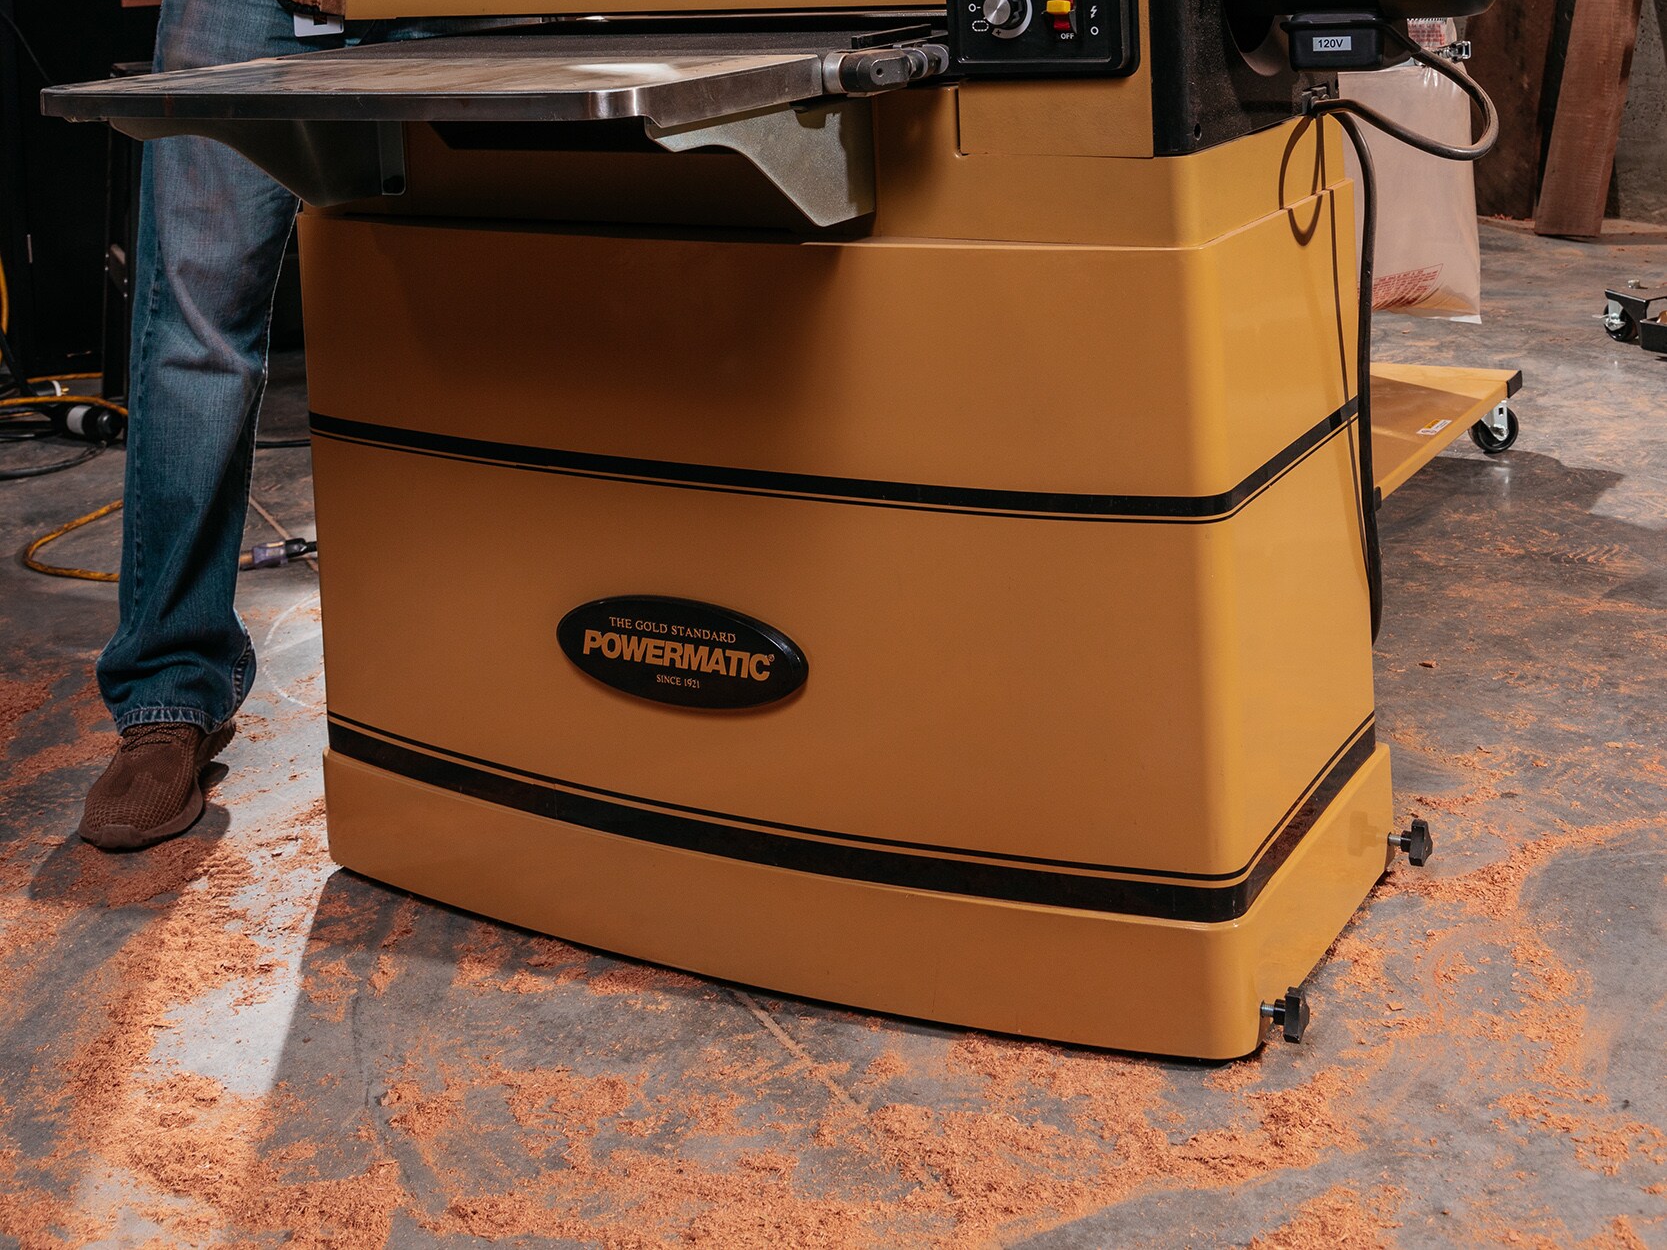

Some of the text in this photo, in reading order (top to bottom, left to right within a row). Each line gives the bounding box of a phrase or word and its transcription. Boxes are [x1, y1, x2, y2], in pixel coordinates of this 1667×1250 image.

[1318, 39, 1343, 48] 120V
[609, 616, 736, 644] THE GOLD STANDARD
[656, 674, 700, 689] SINCE 1921
